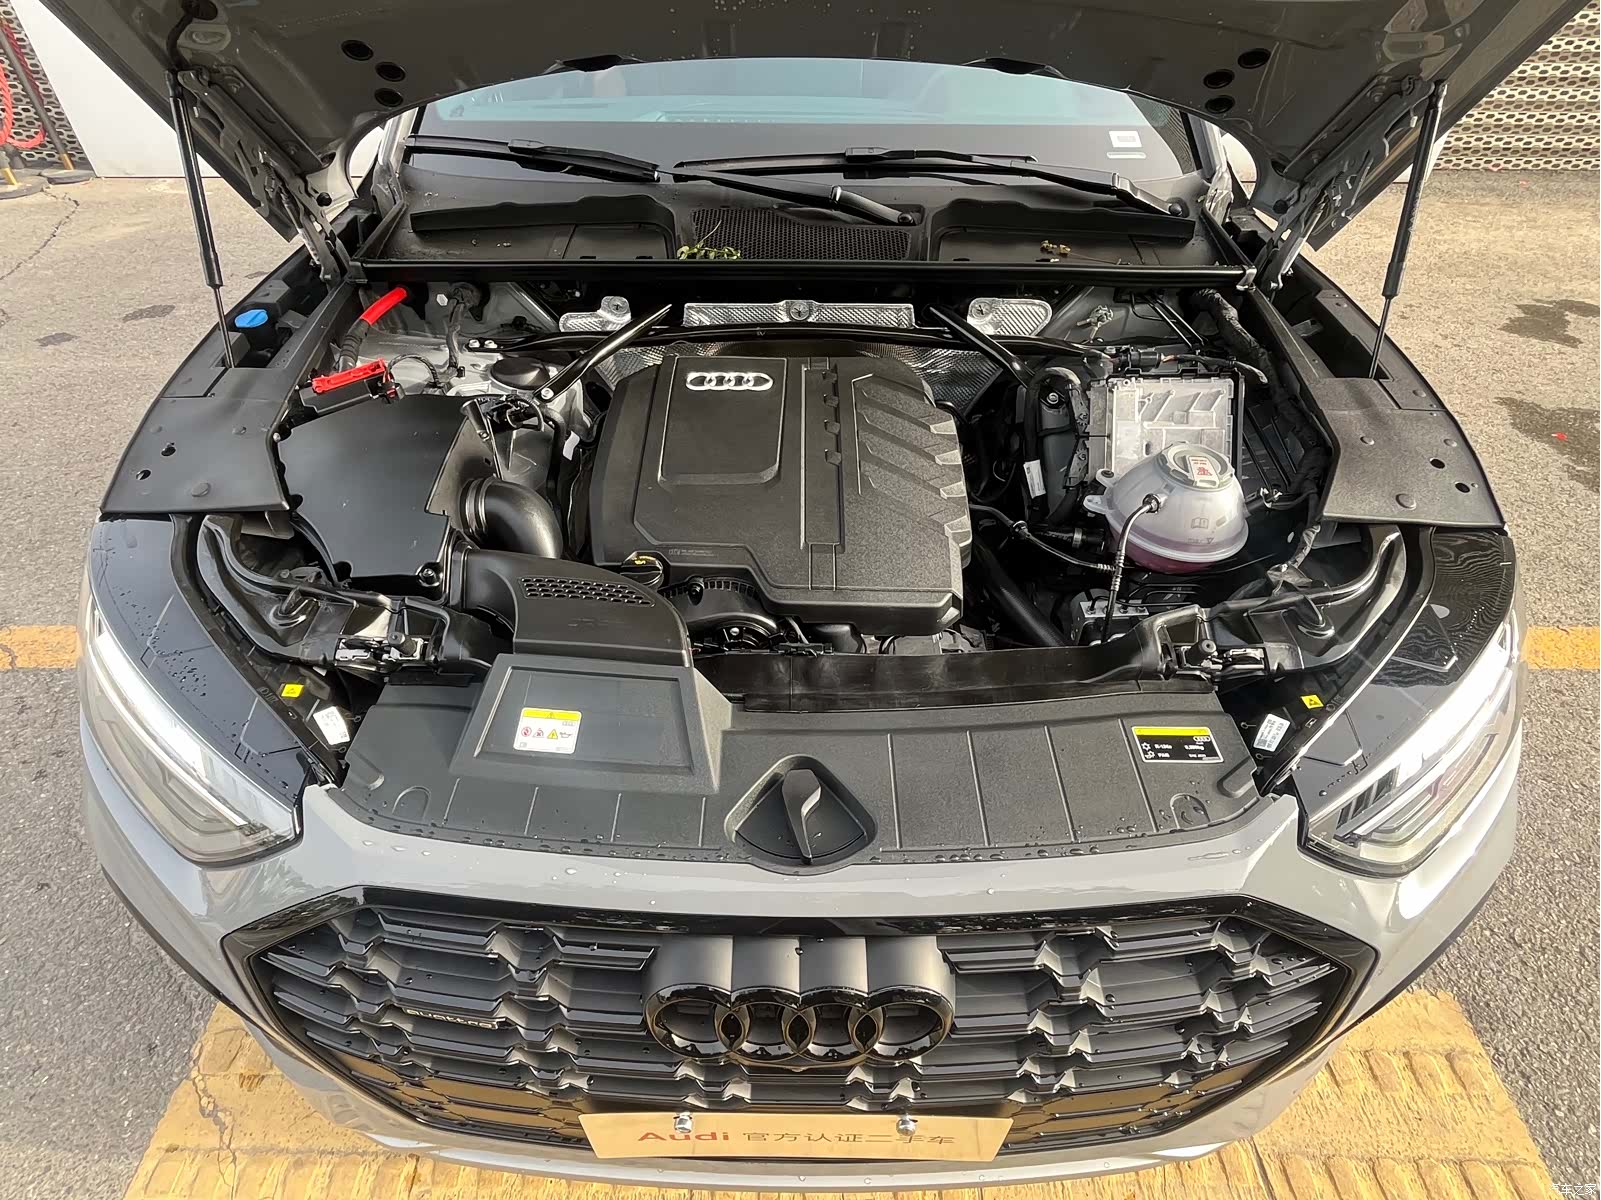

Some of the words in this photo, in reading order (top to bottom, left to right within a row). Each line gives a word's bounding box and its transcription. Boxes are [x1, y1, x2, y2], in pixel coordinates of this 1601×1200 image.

[638, 1131, 730, 1142] Audi
[743, 1132, 956, 1145] 官方认证二手车
